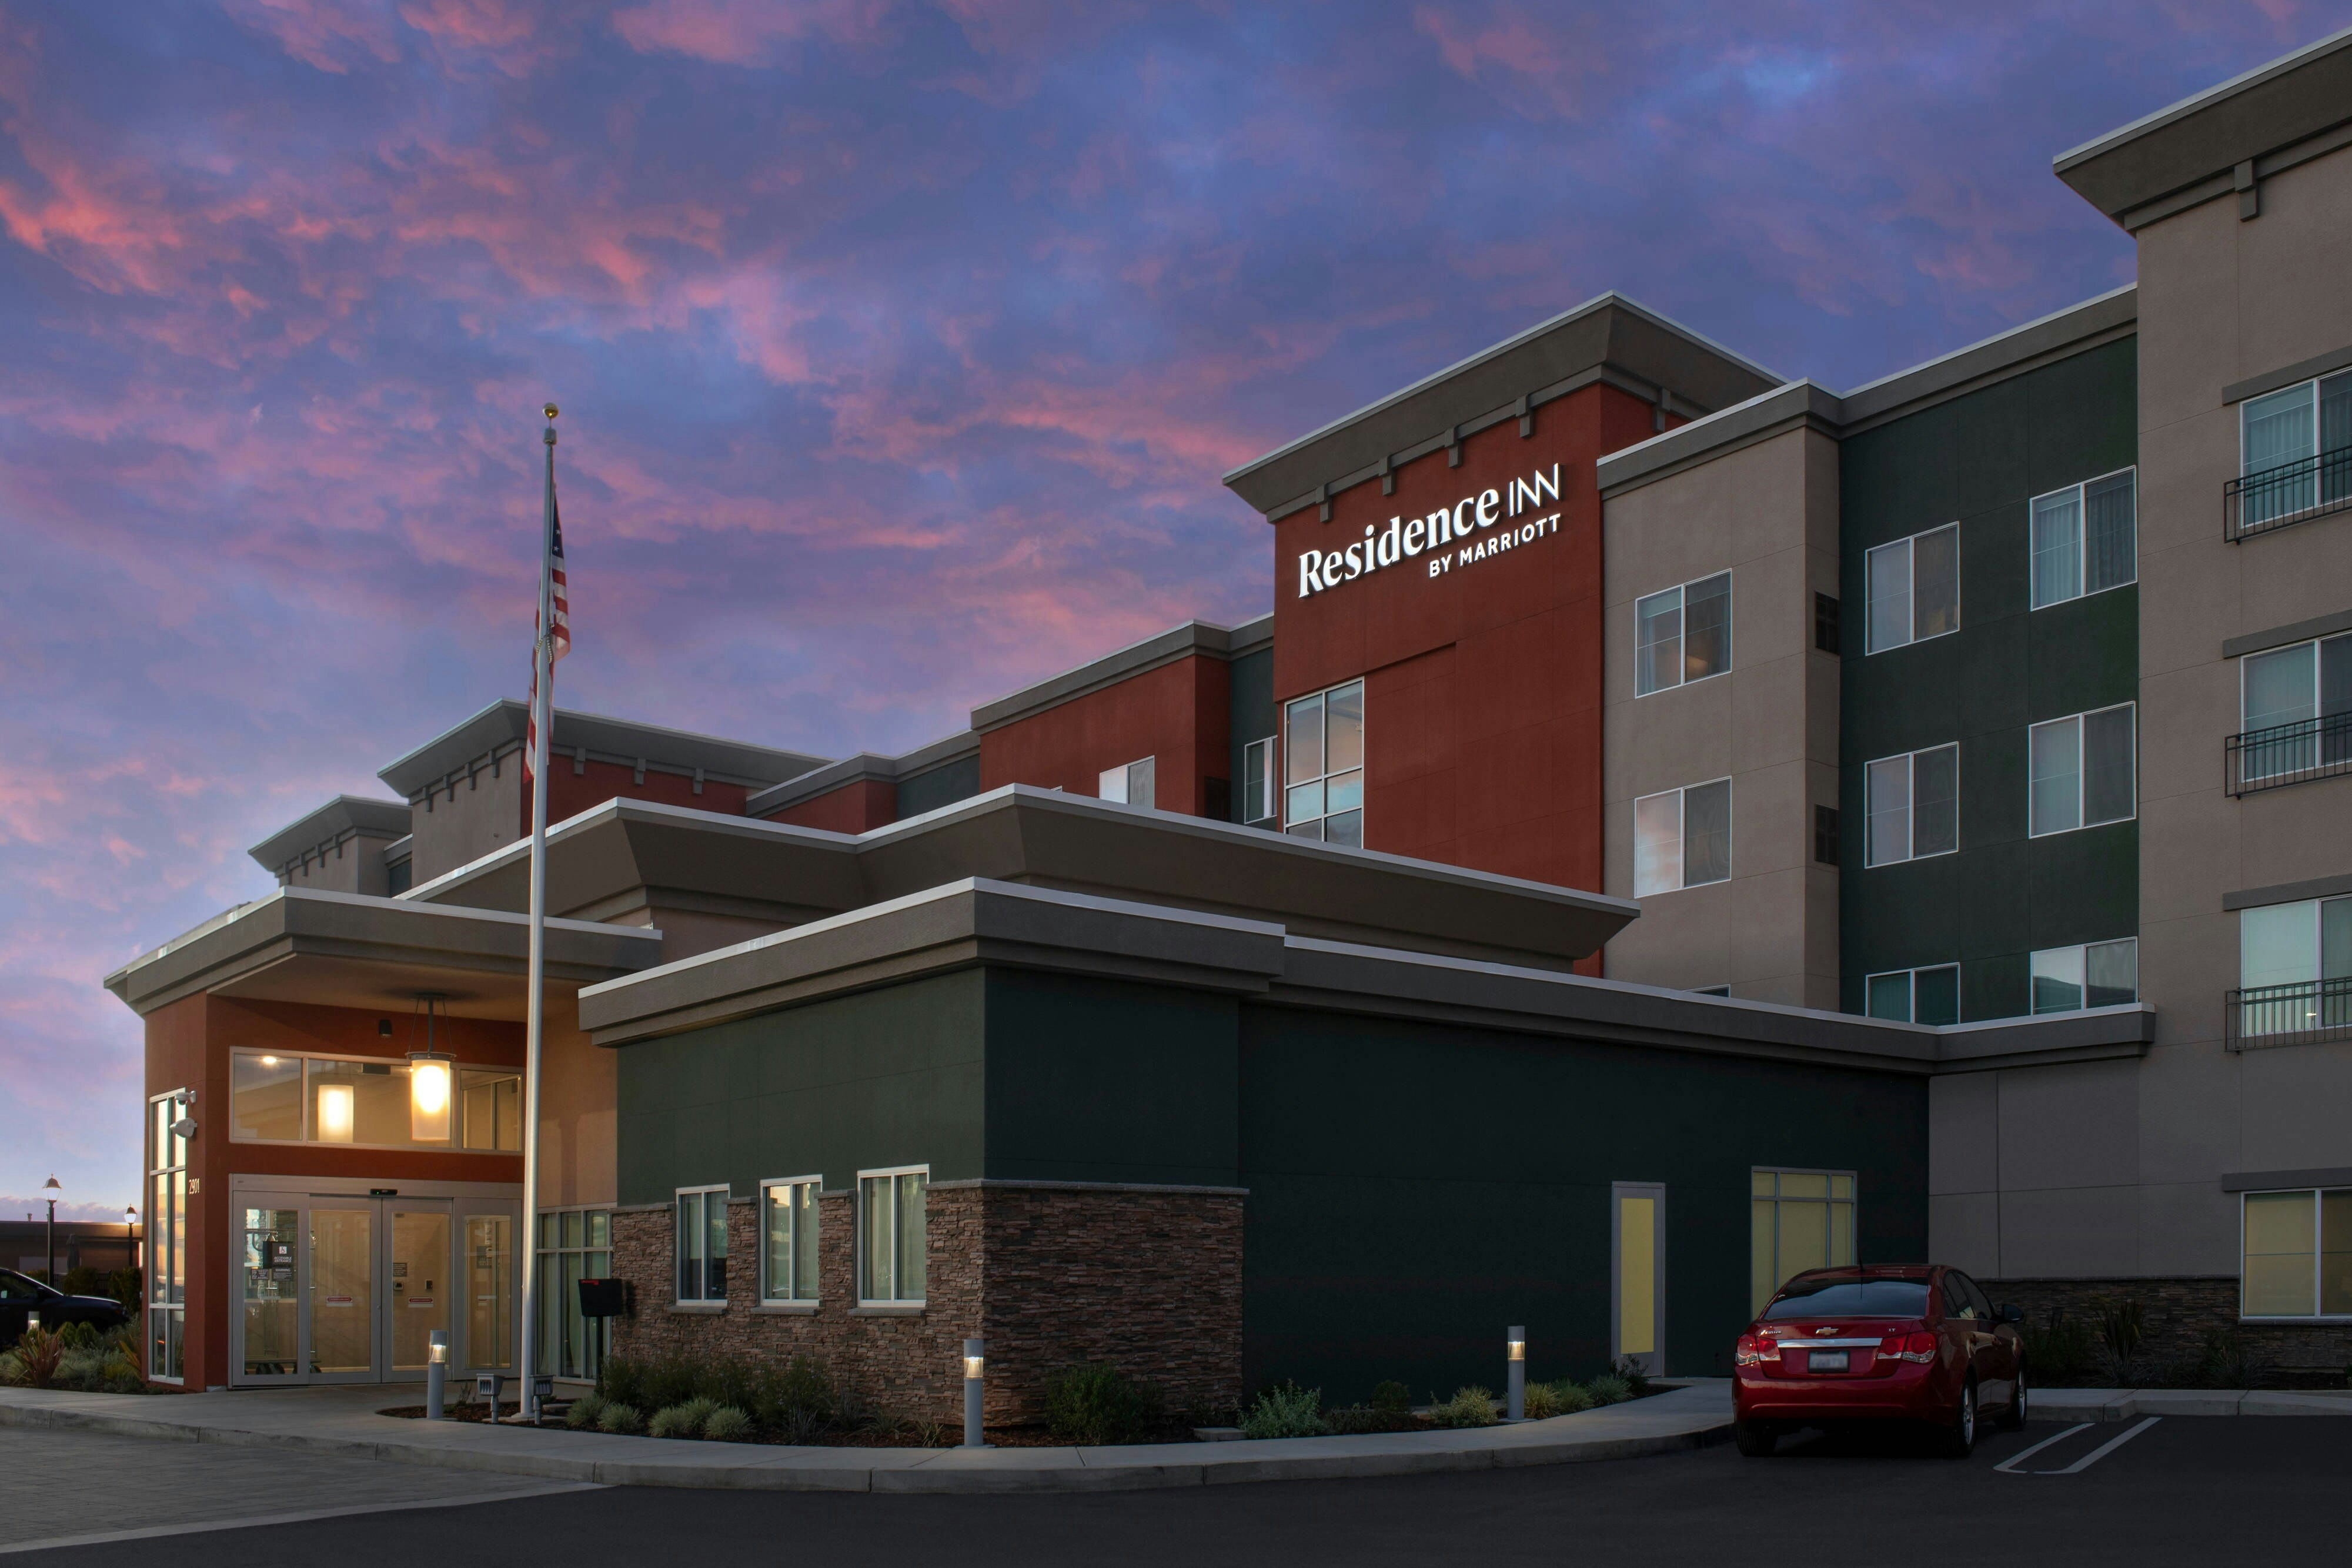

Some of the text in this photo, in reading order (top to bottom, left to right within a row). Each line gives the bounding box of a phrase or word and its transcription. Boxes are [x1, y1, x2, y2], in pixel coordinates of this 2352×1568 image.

[1298, 462, 1559, 598] Residence INN
[1429, 513, 1561, 578] BY MARRIOTT
[188, 1178, 200, 1195] 2901
